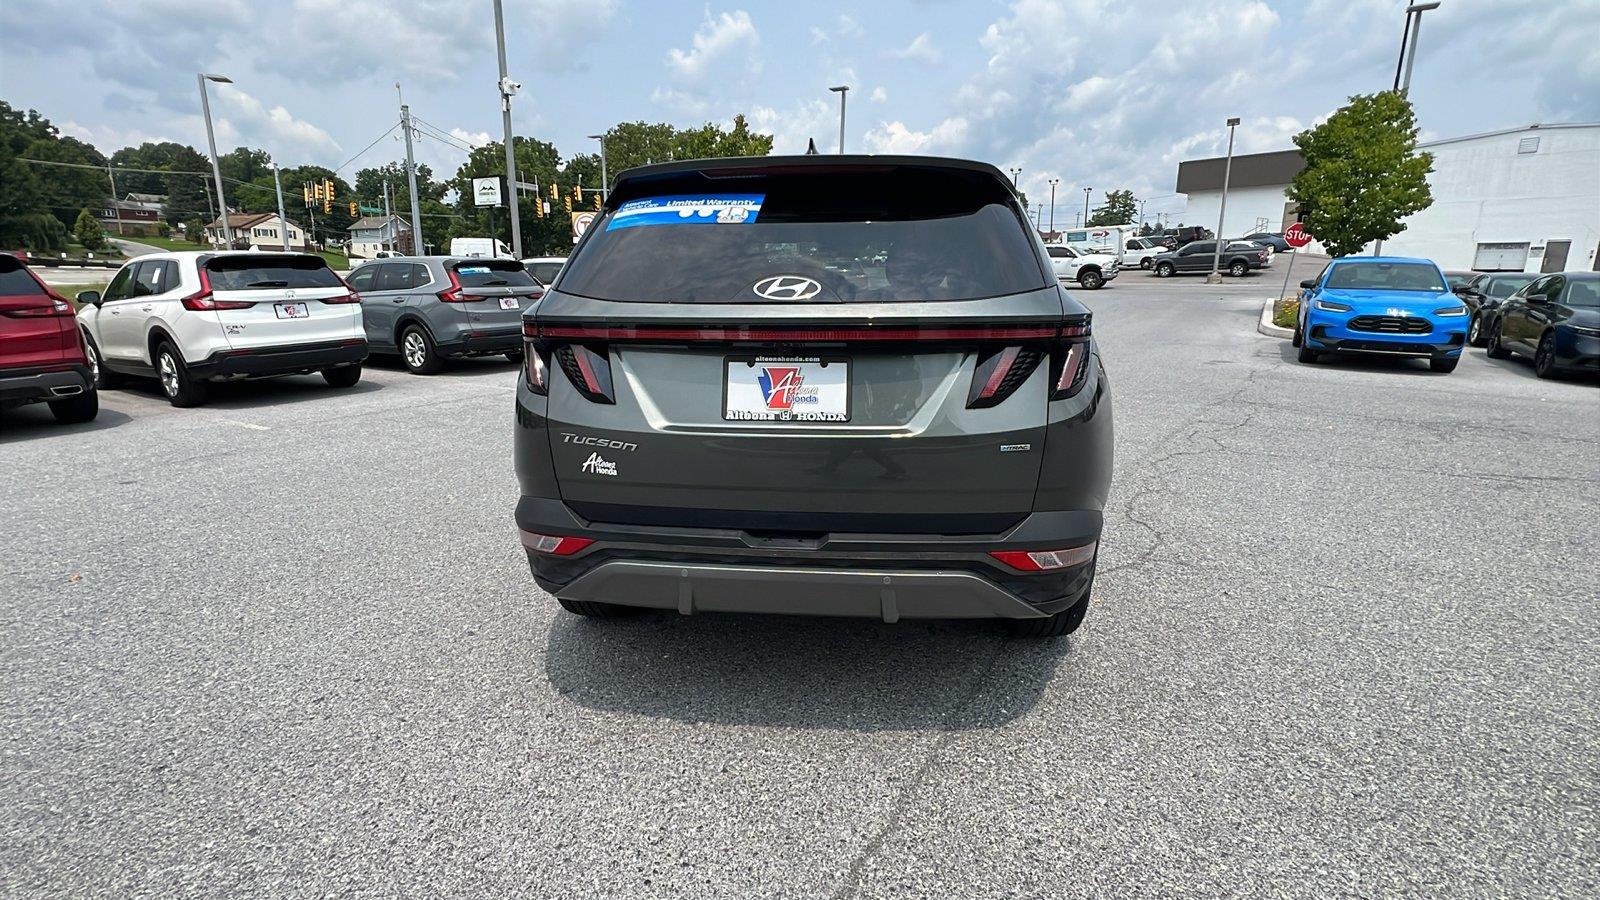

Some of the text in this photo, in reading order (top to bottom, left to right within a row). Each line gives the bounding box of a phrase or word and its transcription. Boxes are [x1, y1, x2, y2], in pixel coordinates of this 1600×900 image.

[666, 199, 705, 207] Limited
[787, 394, 817, 403] Honda
[725, 410, 775, 421] Altoona
[796, 411, 847, 421] HONDA
[596, 467, 618, 476] Honda
